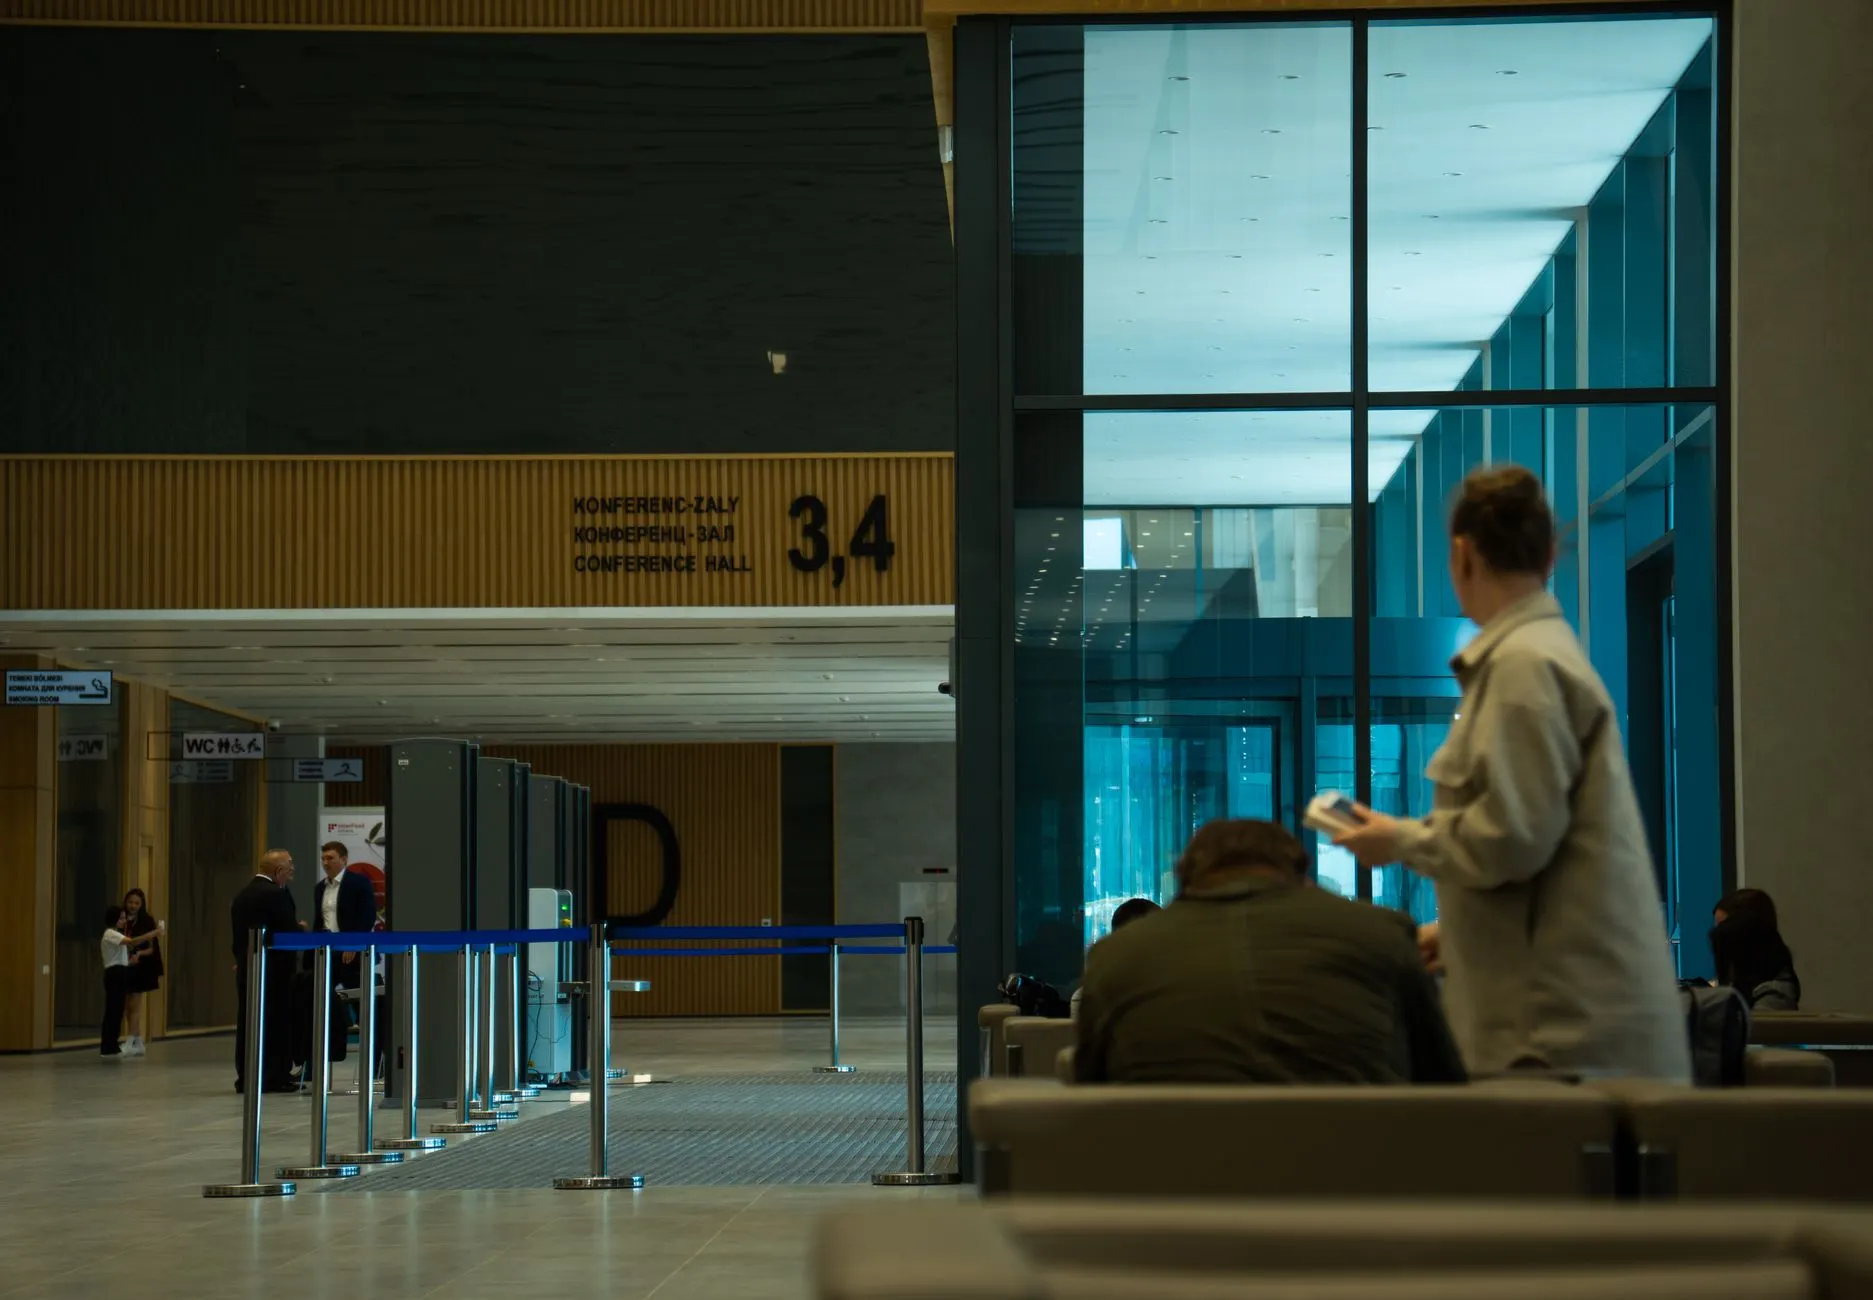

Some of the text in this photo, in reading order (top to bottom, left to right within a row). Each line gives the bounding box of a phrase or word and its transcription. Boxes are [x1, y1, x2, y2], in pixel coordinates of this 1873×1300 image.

[574, 496, 740, 514] KONFERENC-ZALY
[574, 525, 735, 546] КОНФЕРЕНЦ-ЗАЛ
[788, 494, 895, 588] 3,4
[574, 555, 752, 573] CONFERENCE HALL
[185, 738, 215, 754] WC
[591, 804, 681, 928] D
